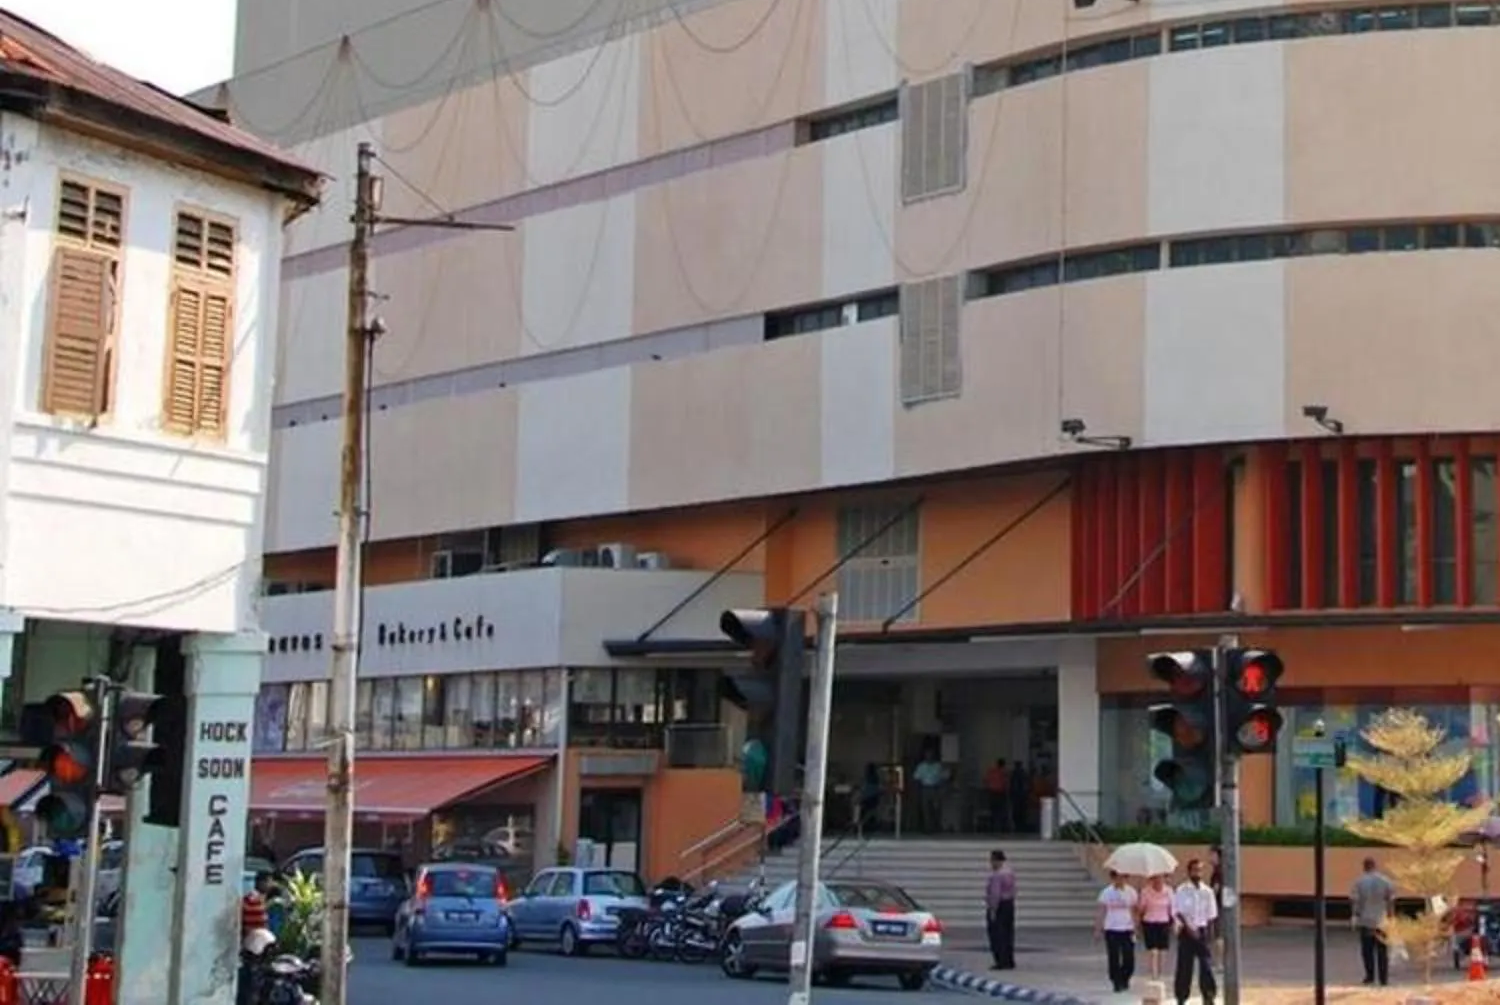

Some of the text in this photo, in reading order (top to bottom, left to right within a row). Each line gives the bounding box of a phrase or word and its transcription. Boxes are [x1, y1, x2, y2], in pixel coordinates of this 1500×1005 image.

[453, 615, 494, 641] Cafe
[200, 721, 248, 742] HOCK
[198, 758, 245, 779] SOON
[205, 794, 228, 884] CAFE
